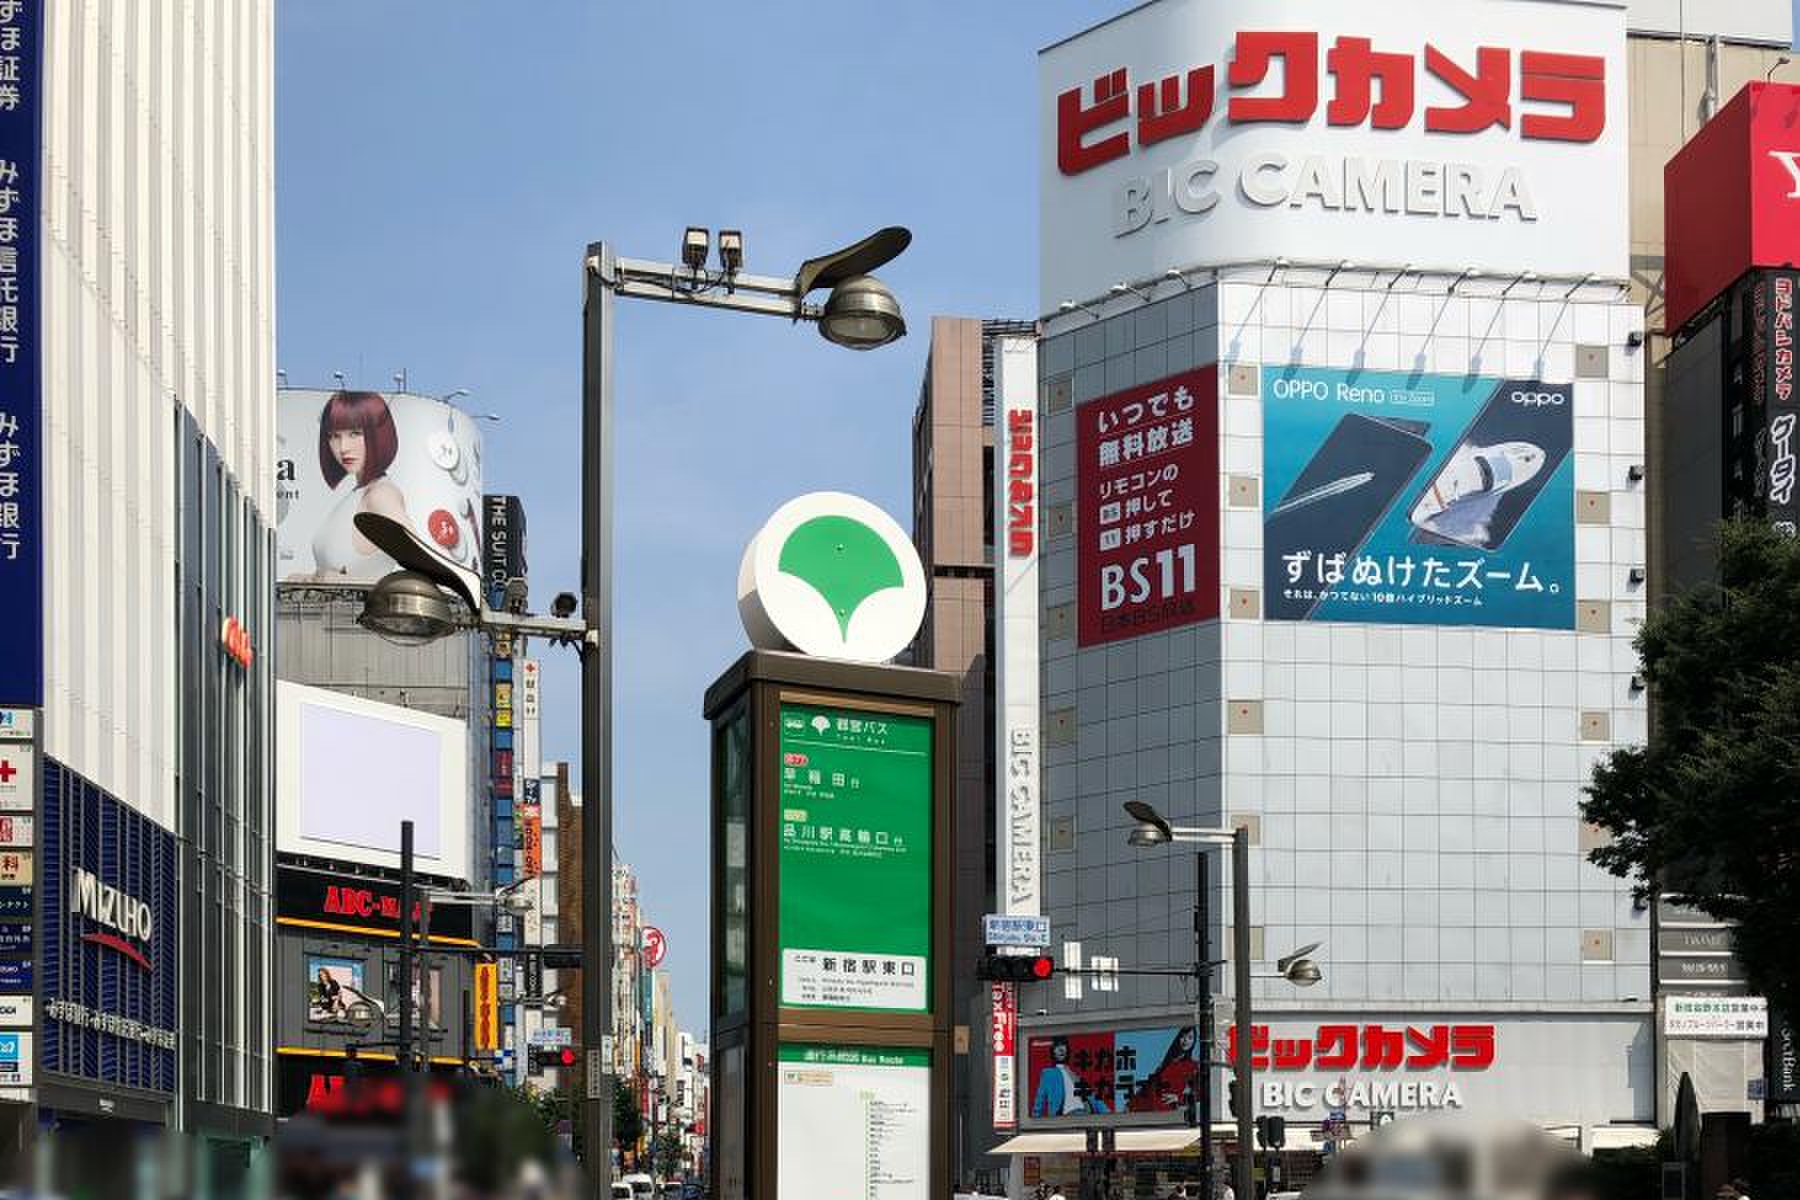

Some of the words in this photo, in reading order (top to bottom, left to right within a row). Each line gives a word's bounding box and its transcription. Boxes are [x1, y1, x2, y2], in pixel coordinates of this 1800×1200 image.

[1057, 31, 1606, 176] ビックカメラ
[1114, 158, 1222, 239] BIC
[1239, 152, 1537, 222] CAMERA
[1774, 278, 1793, 401] ヨドバシカメラ
[1098, 385, 1195, 433] いつでも
[1273, 378, 1329, 401] OPPO
[1337, 383, 1386, 404] Reno
[1511, 391, 1565, 408] oppo
[1099, 417, 1194, 467] 無料放送
[1769, 414, 1797, 504] ケータイ
[1009, 408, 1034, 558] ビックカメラ
[1100, 463, 1179, 500] リモコンの
[1125, 489, 1174, 519] 押して
[491, 496, 507, 527] THE
[1125, 510, 1196, 545] 押すだけ
[491, 533, 507, 571] SUIT
[1282, 549, 1560, 594] ずばぬけたズーム。
[1102, 543, 1196, 611] BS11
[71, 866, 152, 941] MIZUHO
[323, 885, 433, 922] ABC-M
[822, 957, 915, 977] 新宿駅東口
[1227, 1024, 1496, 1070] ビックカメラ
[1262, 1081, 1318, 1107] BIC
[1325, 1081, 1463, 1109] CAMERA
